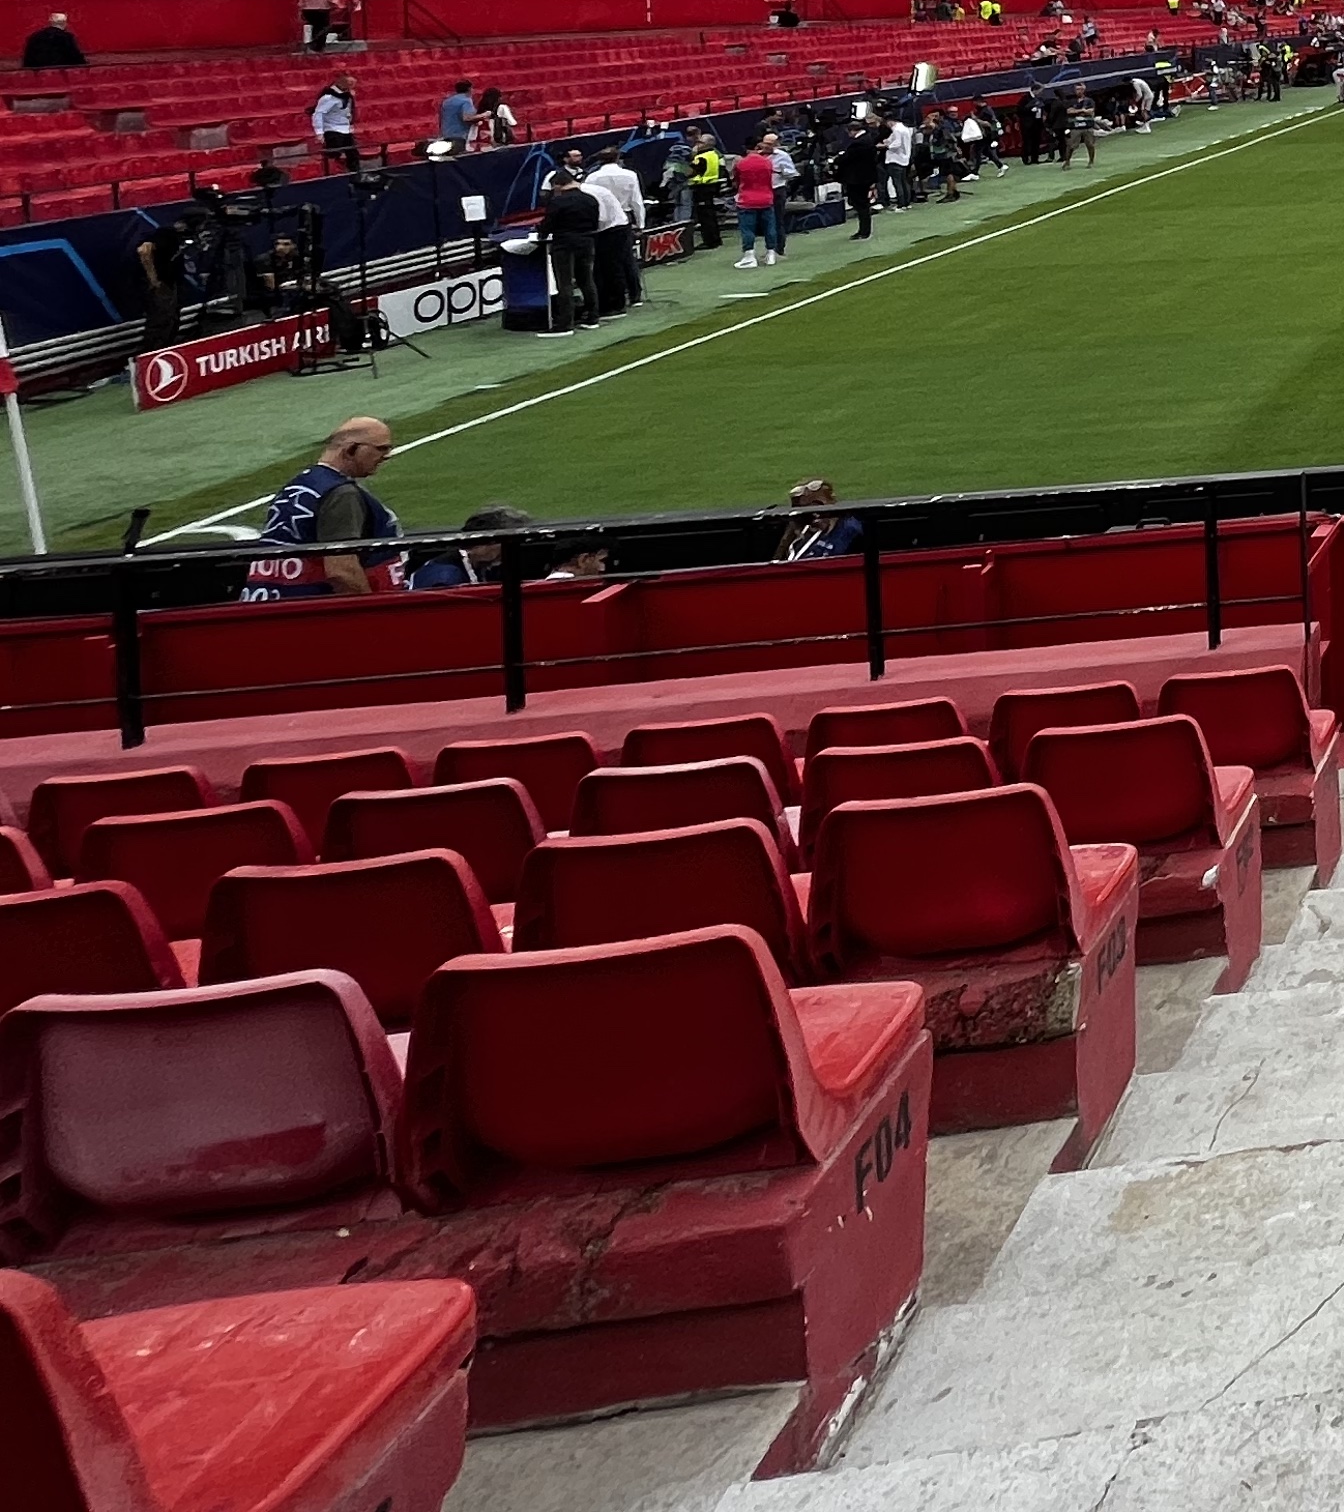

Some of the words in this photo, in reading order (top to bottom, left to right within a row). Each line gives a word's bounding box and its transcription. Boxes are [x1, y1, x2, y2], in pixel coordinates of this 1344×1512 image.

[414, 273, 504, 325] opp
[196, 336, 287, 377] TURKISH
[854, 1090, 912, 1215] F04
